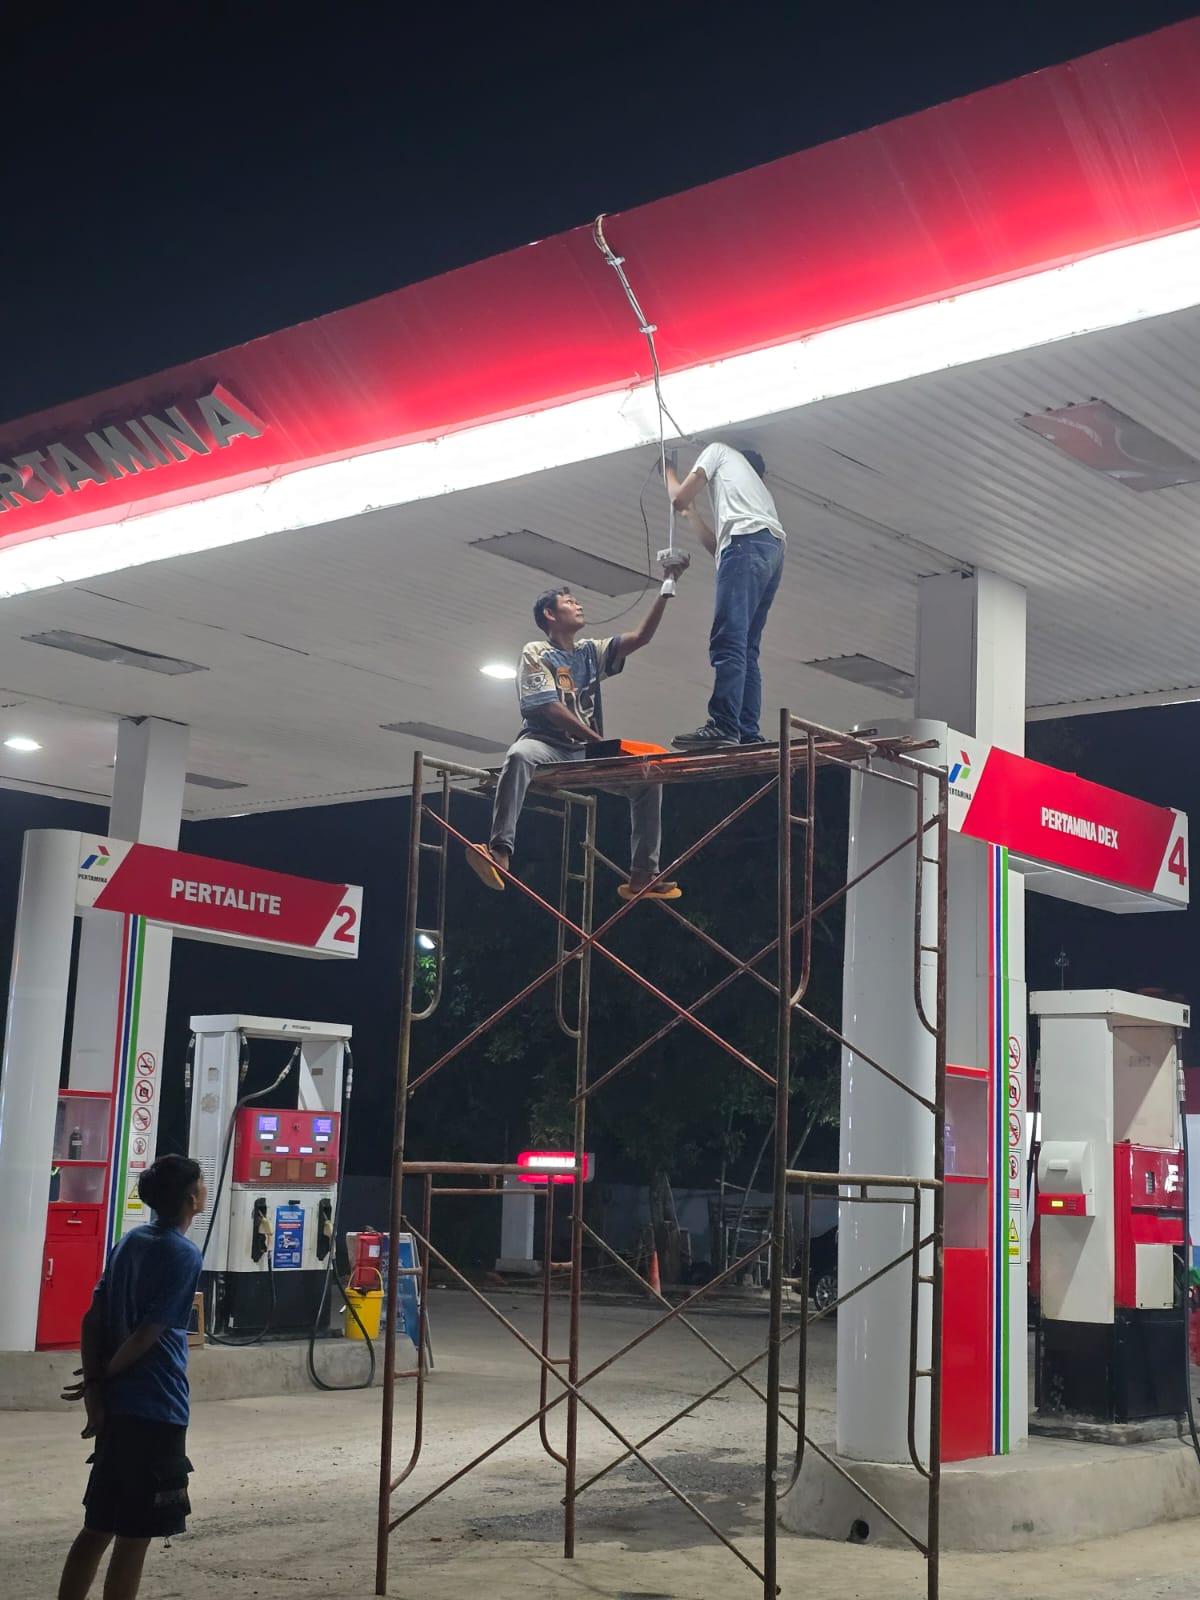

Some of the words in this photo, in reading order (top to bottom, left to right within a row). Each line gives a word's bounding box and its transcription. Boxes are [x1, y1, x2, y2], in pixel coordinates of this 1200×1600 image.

[0, 384, 264, 513] RTAMINA
[1041, 806, 1097, 842] PERTAMINA
[1098, 825, 1119, 850] DEX
[1168, 836, 1188, 886] 4
[170, 878, 282, 916] PERTALITE
[333, 905, 357, 944] 2
